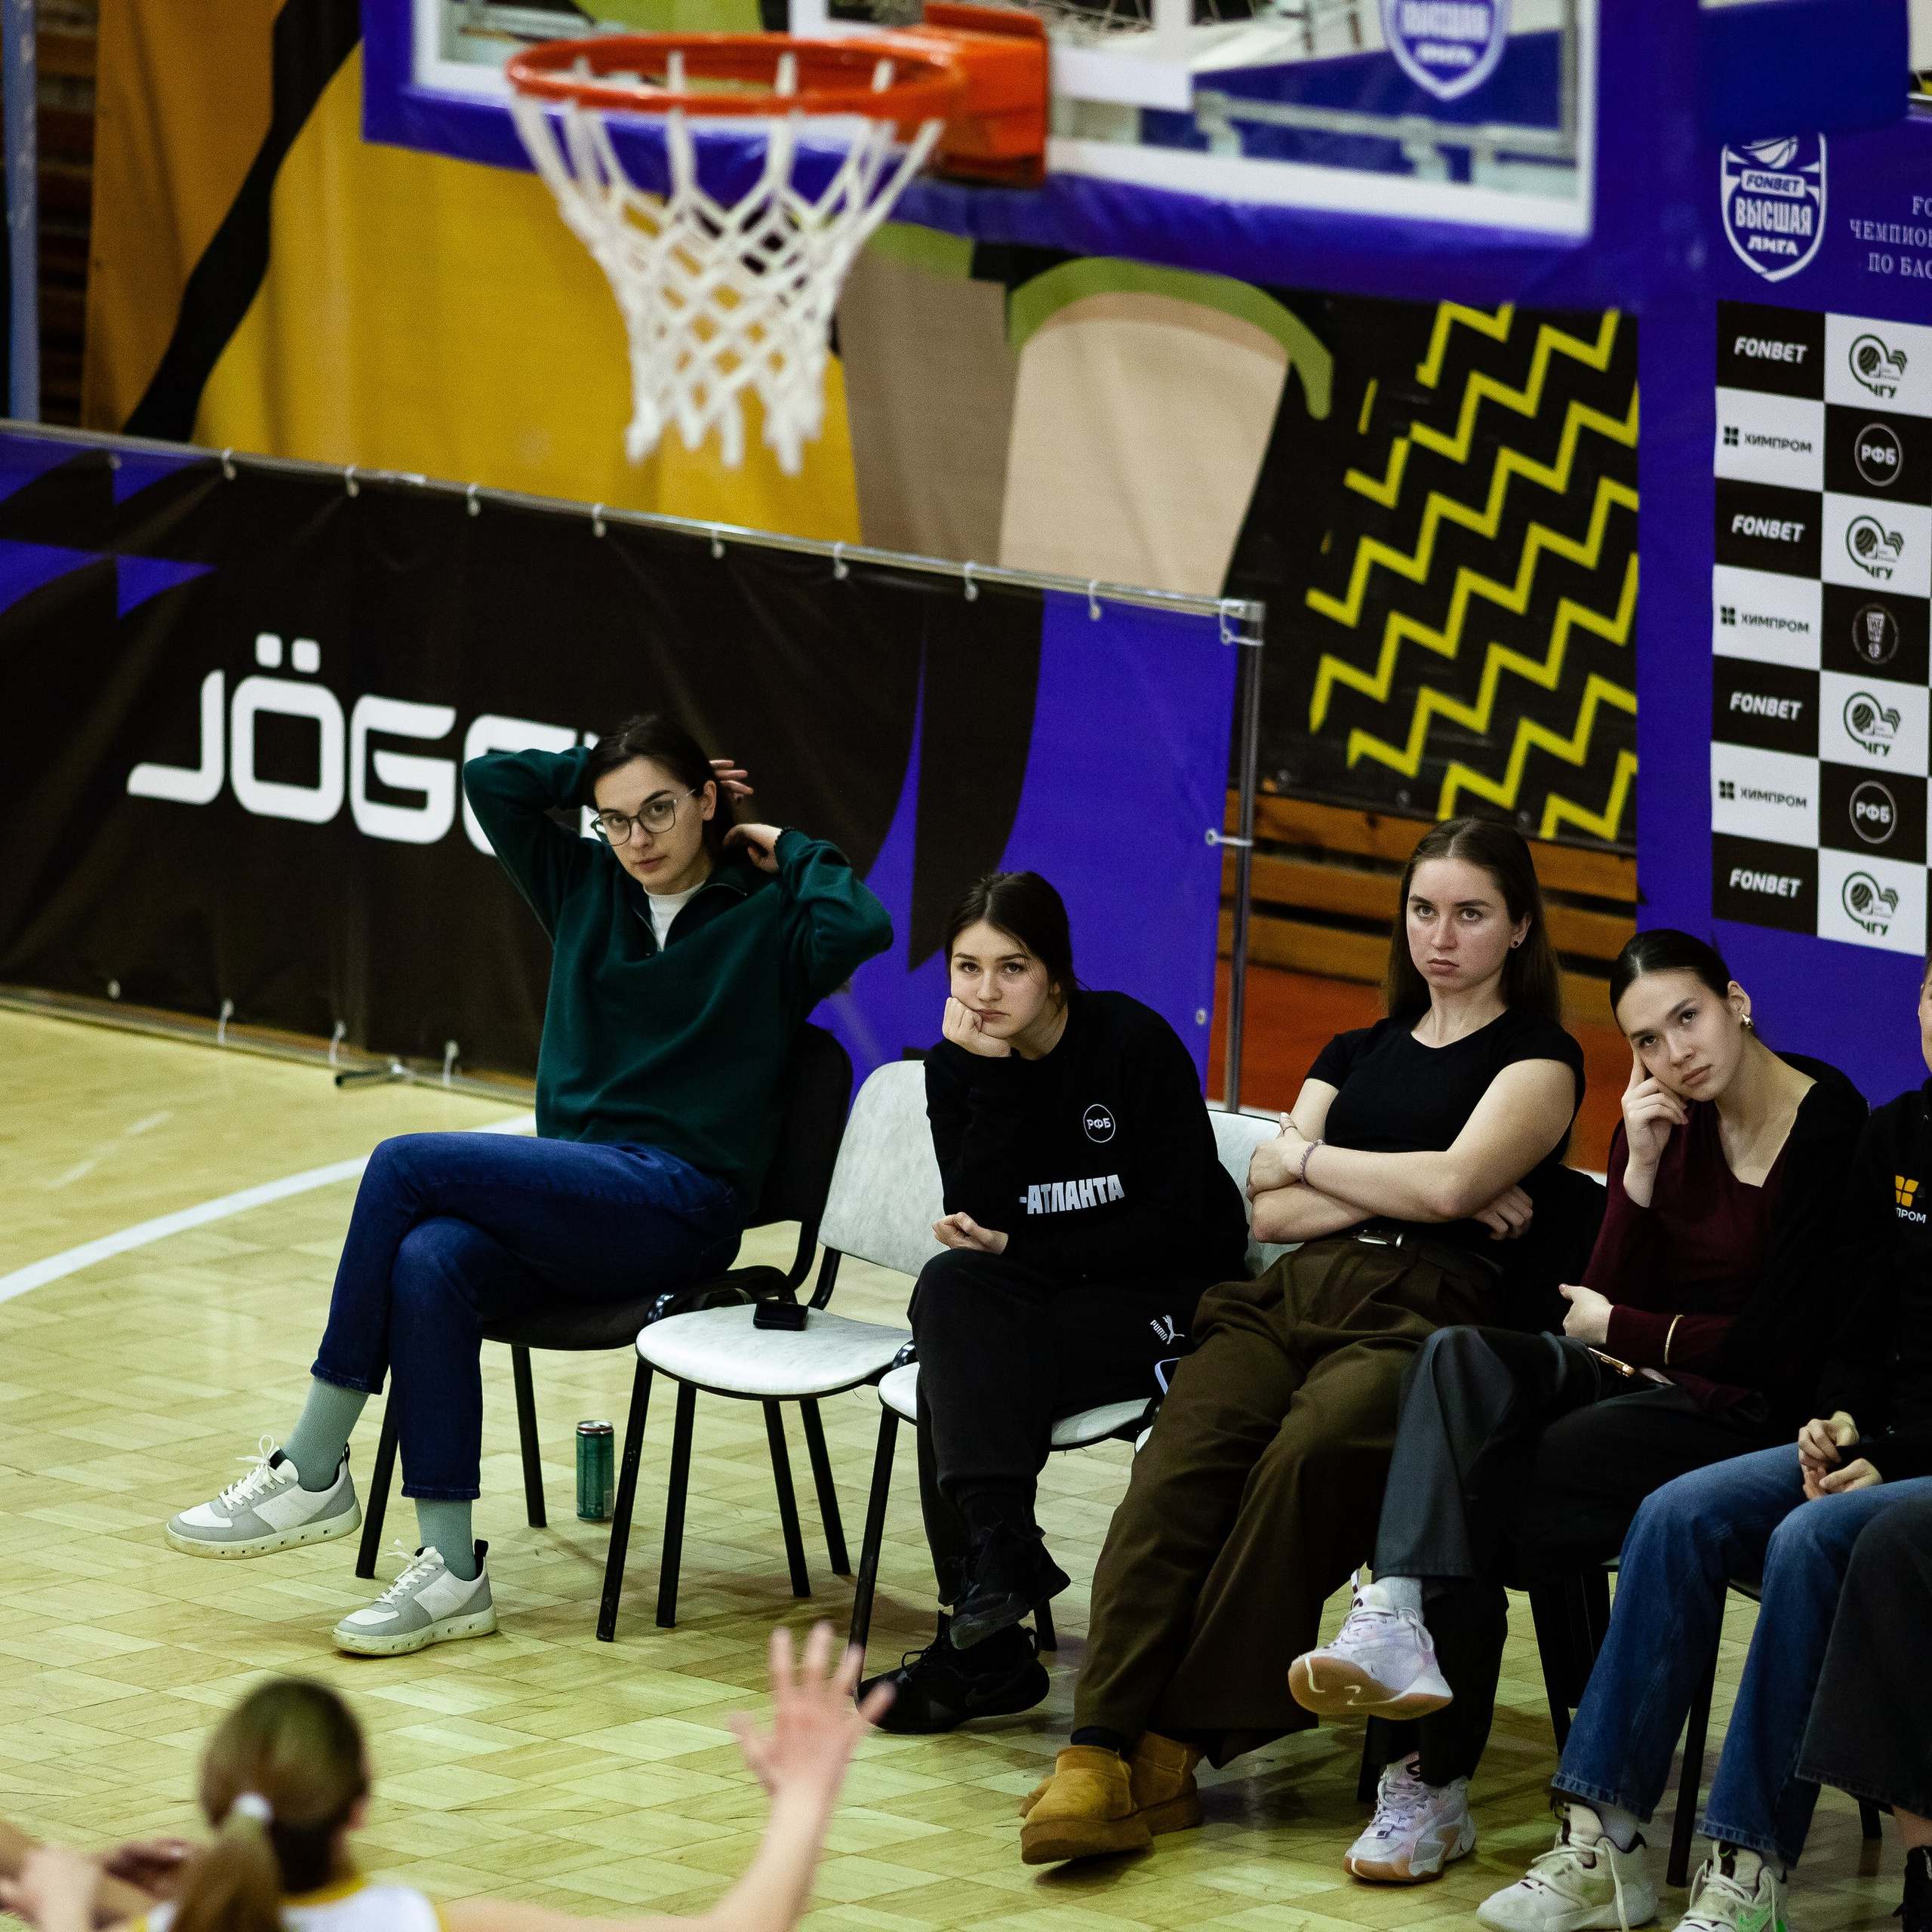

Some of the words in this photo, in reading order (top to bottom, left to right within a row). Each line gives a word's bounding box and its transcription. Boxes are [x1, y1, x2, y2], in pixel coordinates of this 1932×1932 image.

[1746, 174, 1801, 192] FONBET
[1735, 196, 1813, 237] ВЫСШАЯ
[1748, 235, 1799, 257] ЛИГА
[1868, 251, 1895, 274] ПО
[1734, 336, 1808, 365] FONBET
[1744, 432, 1813, 454] ХИМПРОМ
[1861, 444, 1897, 466] РФБ
[1731, 514, 1805, 543] FONBET
[1741, 613, 1810, 634] ХИМПРОМ
[1730, 691, 1803, 721] FONBET
[127, 632, 607, 857] JÖG
[1740, 787, 1807, 809] ХИМПРОМ
[1855, 801, 1891, 823] РФБ
[1729, 868, 1802, 898] FONBET
[1087, 1118, 1111, 1130] РФБ
[1149, 1319, 1168, 1341] PUMA
